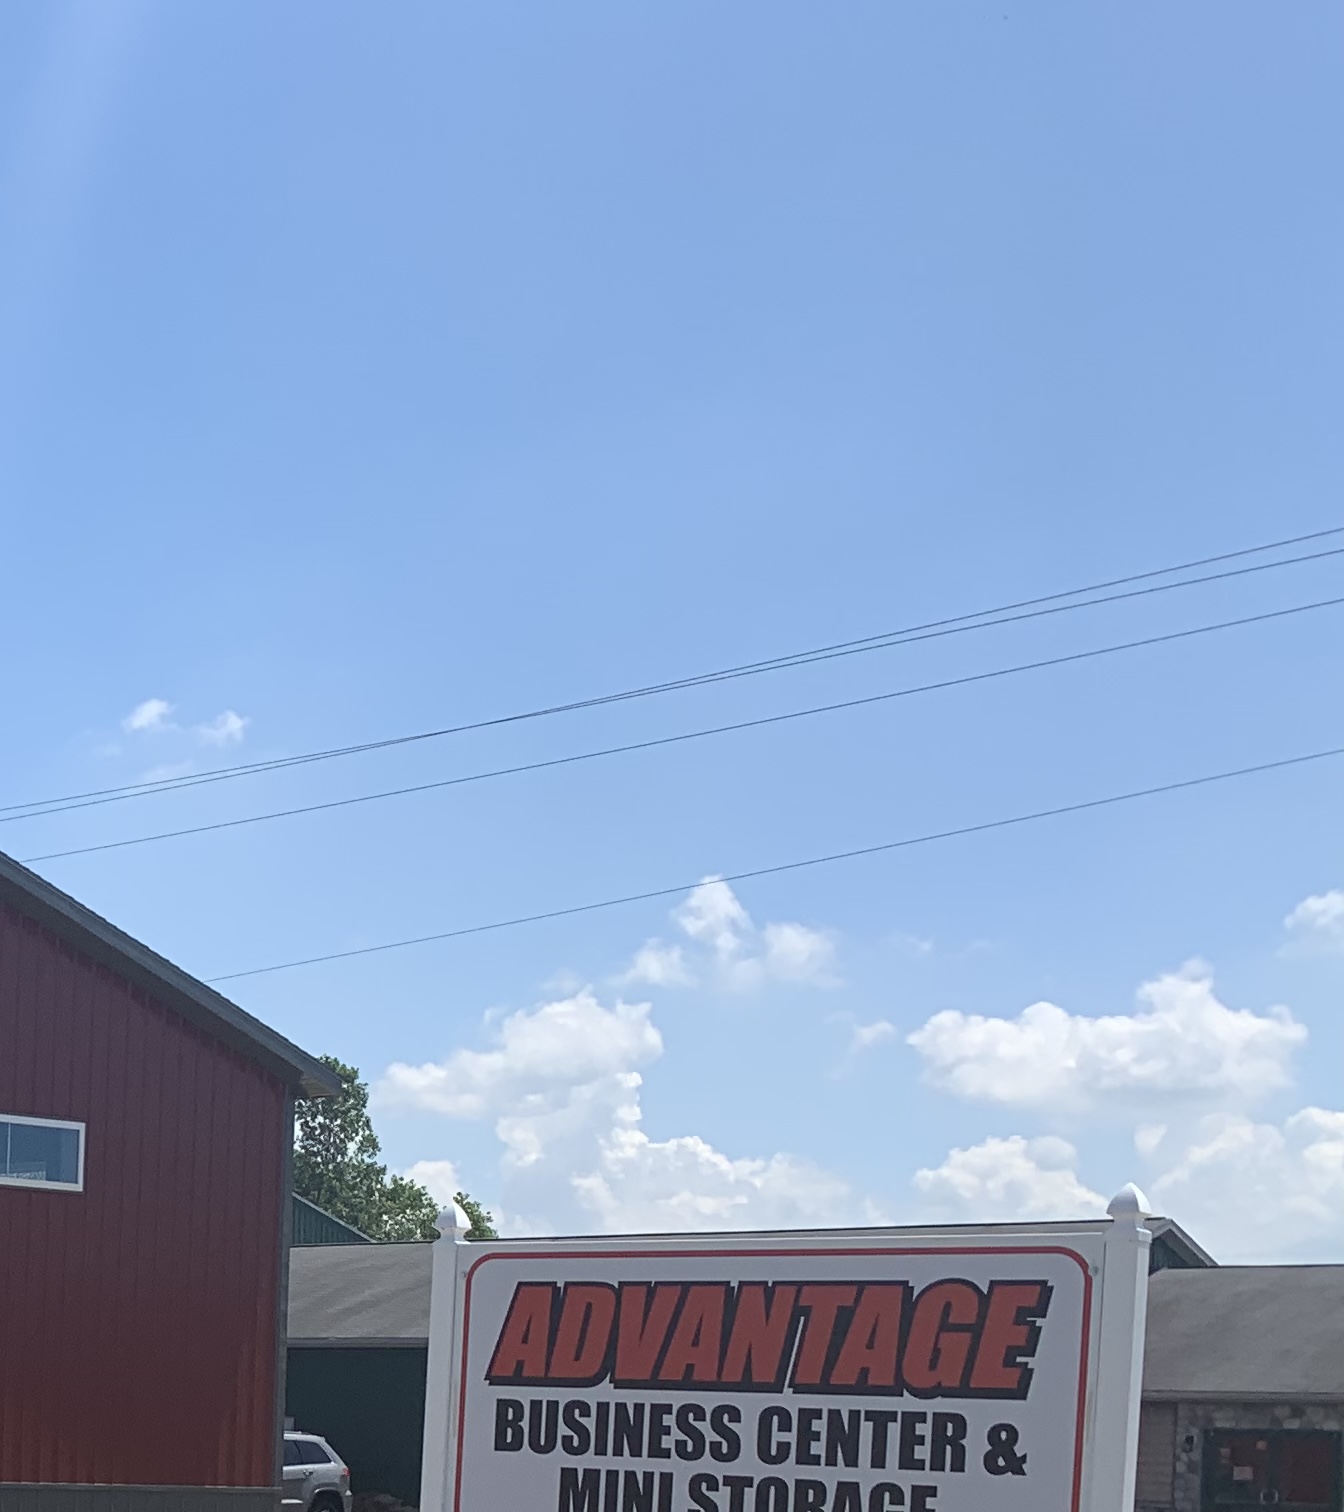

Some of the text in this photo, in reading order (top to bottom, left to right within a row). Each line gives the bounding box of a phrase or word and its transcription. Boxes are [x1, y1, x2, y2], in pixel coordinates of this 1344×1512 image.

[485, 1280, 1054, 1400] ADVANTAGE
[493, 1399, 1027, 1476] BUSINESS CENTER &
